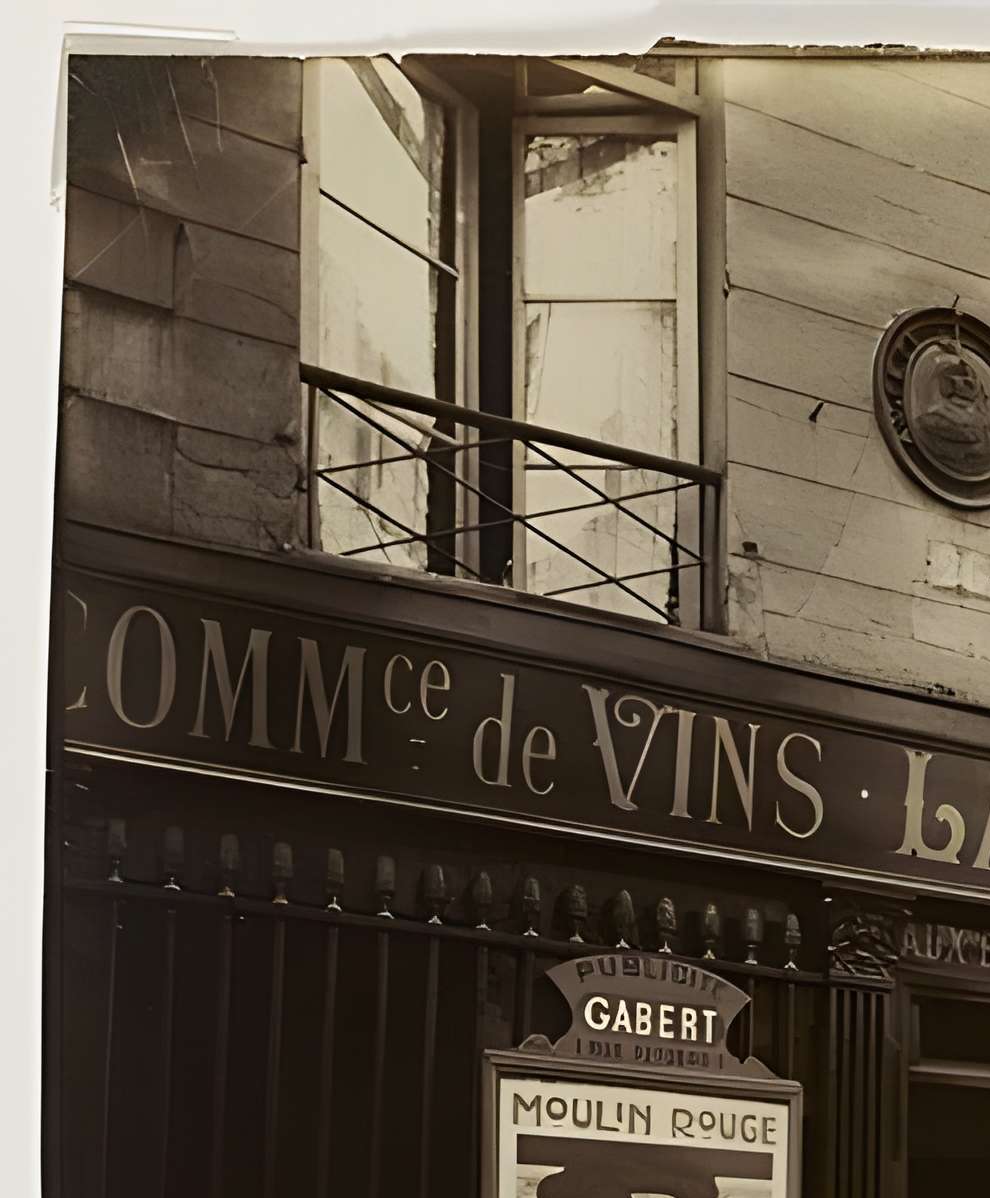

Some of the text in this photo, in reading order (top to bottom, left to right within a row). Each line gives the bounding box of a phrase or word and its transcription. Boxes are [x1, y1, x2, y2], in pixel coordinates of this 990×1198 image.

[472, 673, 557, 795] de
[581, 684, 824, 838] VINS
[584, 996, 718, 1044] GABERT
[512, 1092, 777, 1145] MOULIN ROUGE
